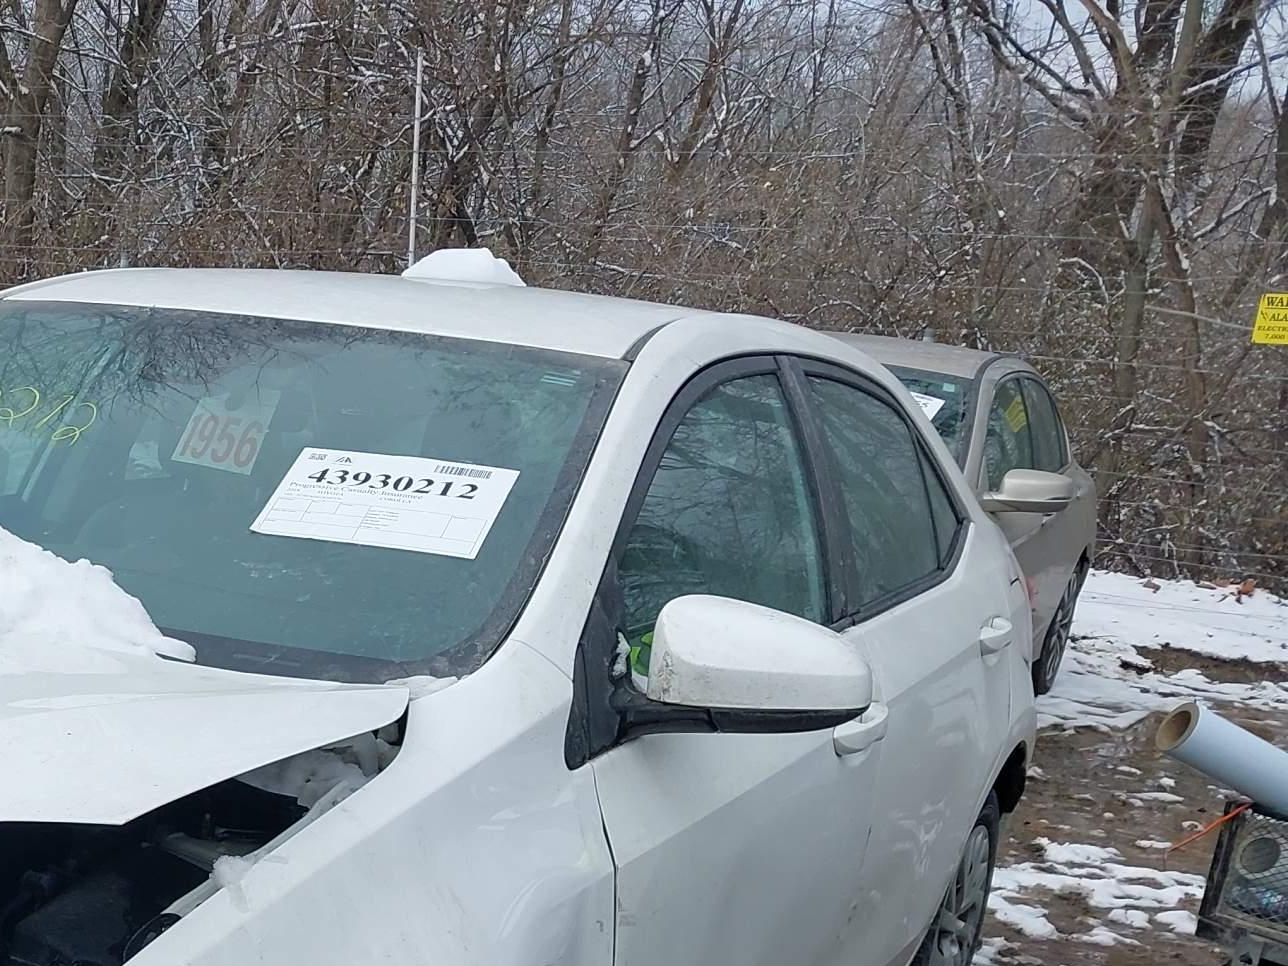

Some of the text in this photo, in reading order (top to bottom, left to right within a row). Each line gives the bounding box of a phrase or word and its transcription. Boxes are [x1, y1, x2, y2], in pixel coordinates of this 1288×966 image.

[1266, 296, 1288, 307] WA
[179, 411, 264, 468] 1956
[308, 467, 479, 500] 43930212
